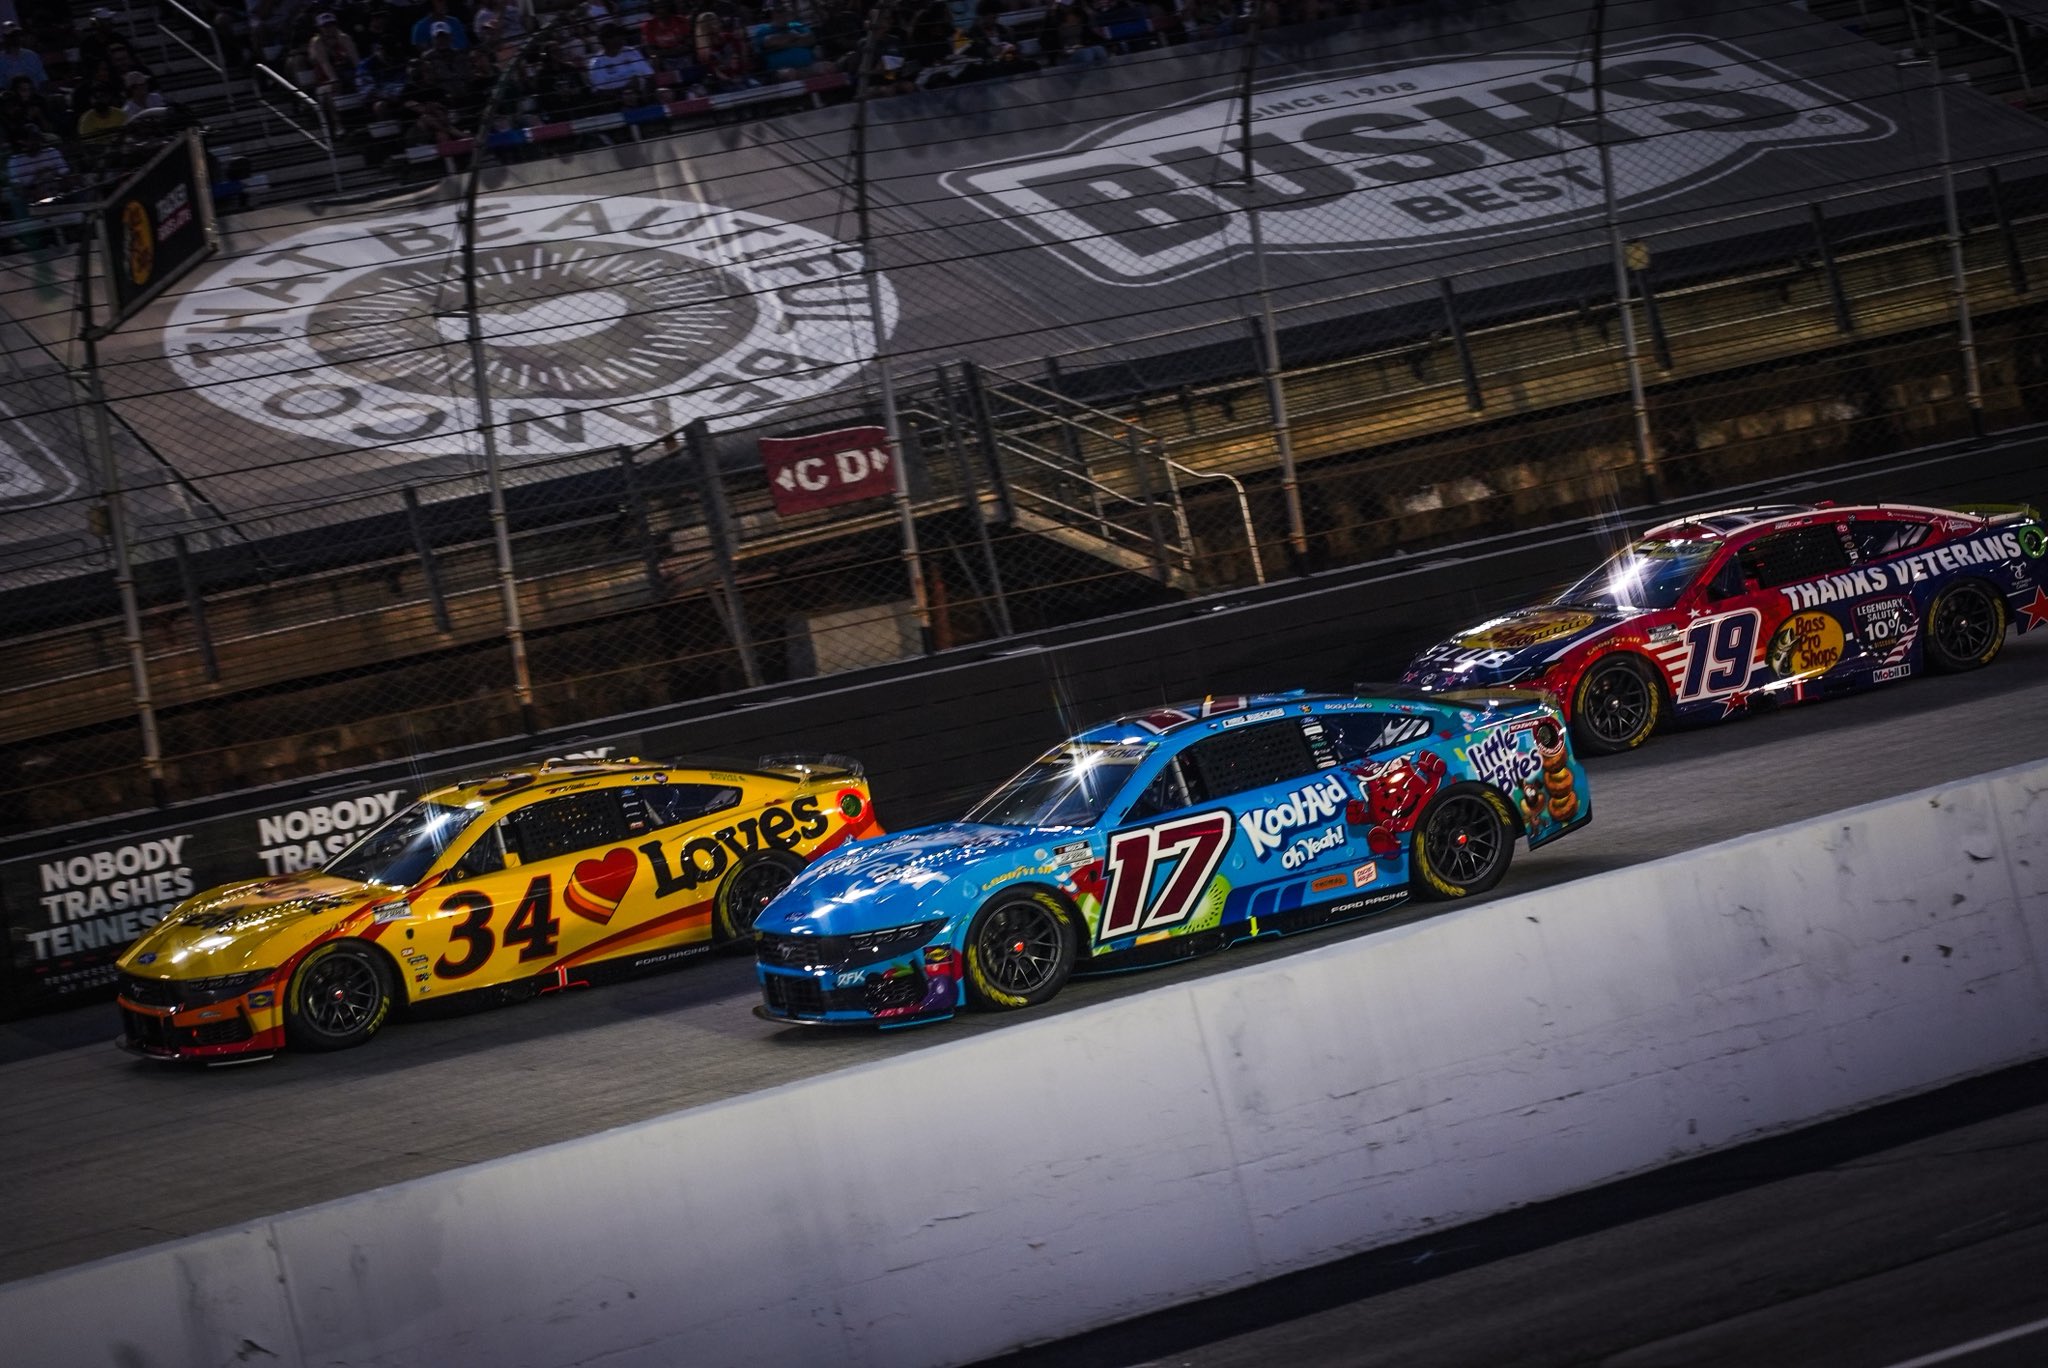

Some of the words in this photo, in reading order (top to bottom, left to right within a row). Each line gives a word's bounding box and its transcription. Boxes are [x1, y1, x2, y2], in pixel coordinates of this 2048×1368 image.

[1246, 94, 1334, 121] SINCE
[1341, 82, 1416, 109] 1908
[1017, 59, 1802, 258] BUSH'S
[1393, 165, 1606, 224] BEST
[794, 457, 830, 491] C
[834, 449, 870, 484] D
[1779, 566, 1889, 611] THANKS
[1888, 532, 2022, 586] VETERANS
[1795, 615, 1826, 636] Bass
[1857, 598, 1904, 617] LEGENDARY
[1864, 617, 1907, 640] 10%
[1867, 608, 1899, 622] SALUTE
[1680, 607, 1761, 703] 19
[1798, 634, 1821, 652] Pro
[1800, 646, 1838, 669] Shops
[1874, 667, 1900, 681] Mobil
[1495, 749, 1542, 796] Bites
[257, 791, 399, 846] NOBODY
[1238, 774, 1348, 858] Kool-Aid
[39, 835, 187, 892] NOBODY
[257, 828, 371, 876] TRAS
[1297, 825, 1345, 860] Yeah!
[40, 867, 195, 924] TRASHES
[1101, 807, 1234, 941] 17
[1330, 900, 1364, 913] FORD
[1365, 890, 1409, 906] RACING
[26, 903, 174, 960] TENNES
[434, 873, 560, 981] 34
[635, 954, 667, 967] FORD
[668, 945, 710, 960] RACING
